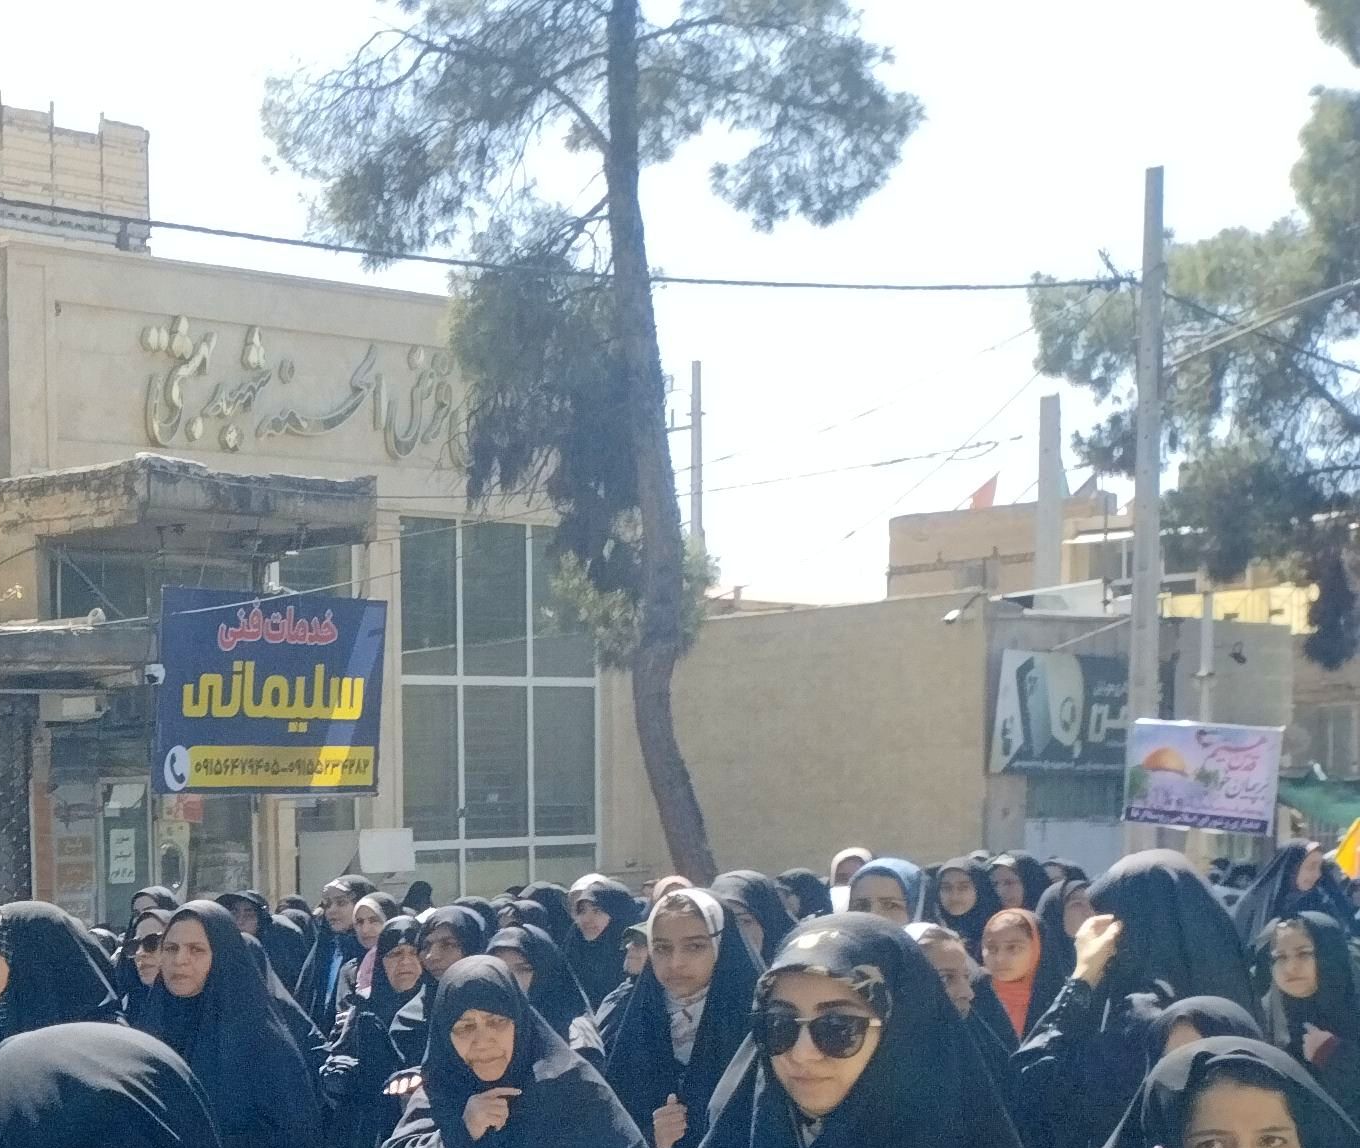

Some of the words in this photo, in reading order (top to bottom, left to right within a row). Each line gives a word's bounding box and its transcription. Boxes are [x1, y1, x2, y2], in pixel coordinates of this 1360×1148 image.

[217, 596, 264, 652] فنی
[262, 605, 339, 647] خدمات
[181, 659, 366, 734] سلیمانی
